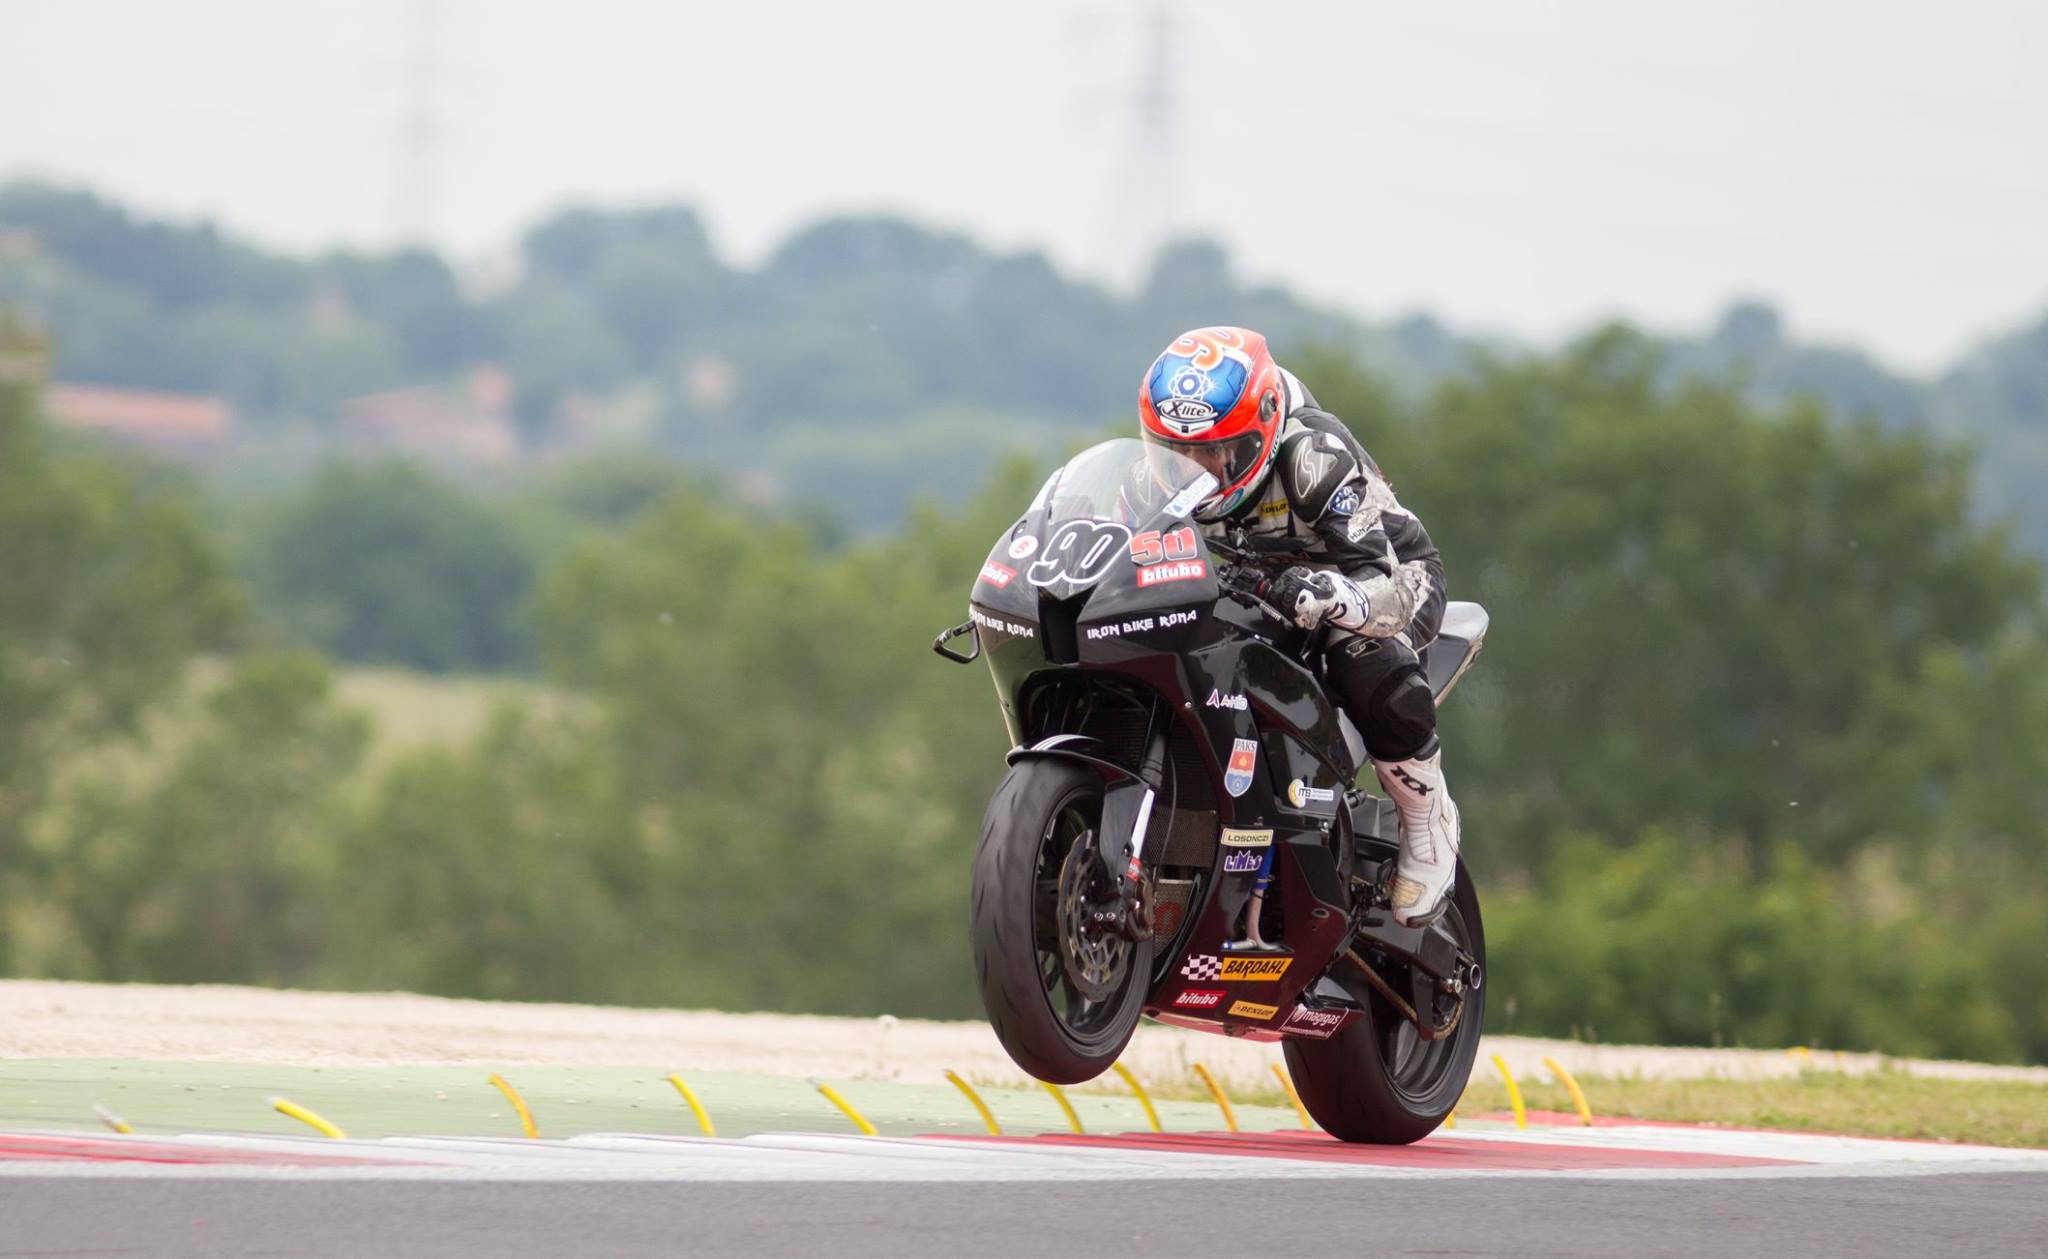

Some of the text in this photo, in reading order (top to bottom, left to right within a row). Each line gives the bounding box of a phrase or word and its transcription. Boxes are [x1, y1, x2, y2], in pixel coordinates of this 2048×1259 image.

[1027, 520, 1132, 586] 90
[1130, 527, 1197, 565] 50
[1143, 564, 1203, 583] bitubo
[1006, 622, 1034, 638] ROMA
[1086, 609, 1198, 640] IRON BIKE ROMA
[1235, 739, 1256, 751] PAKS
[1223, 960, 1286, 978] BARDAHL
[1176, 991, 1218, 1005] bitubo
